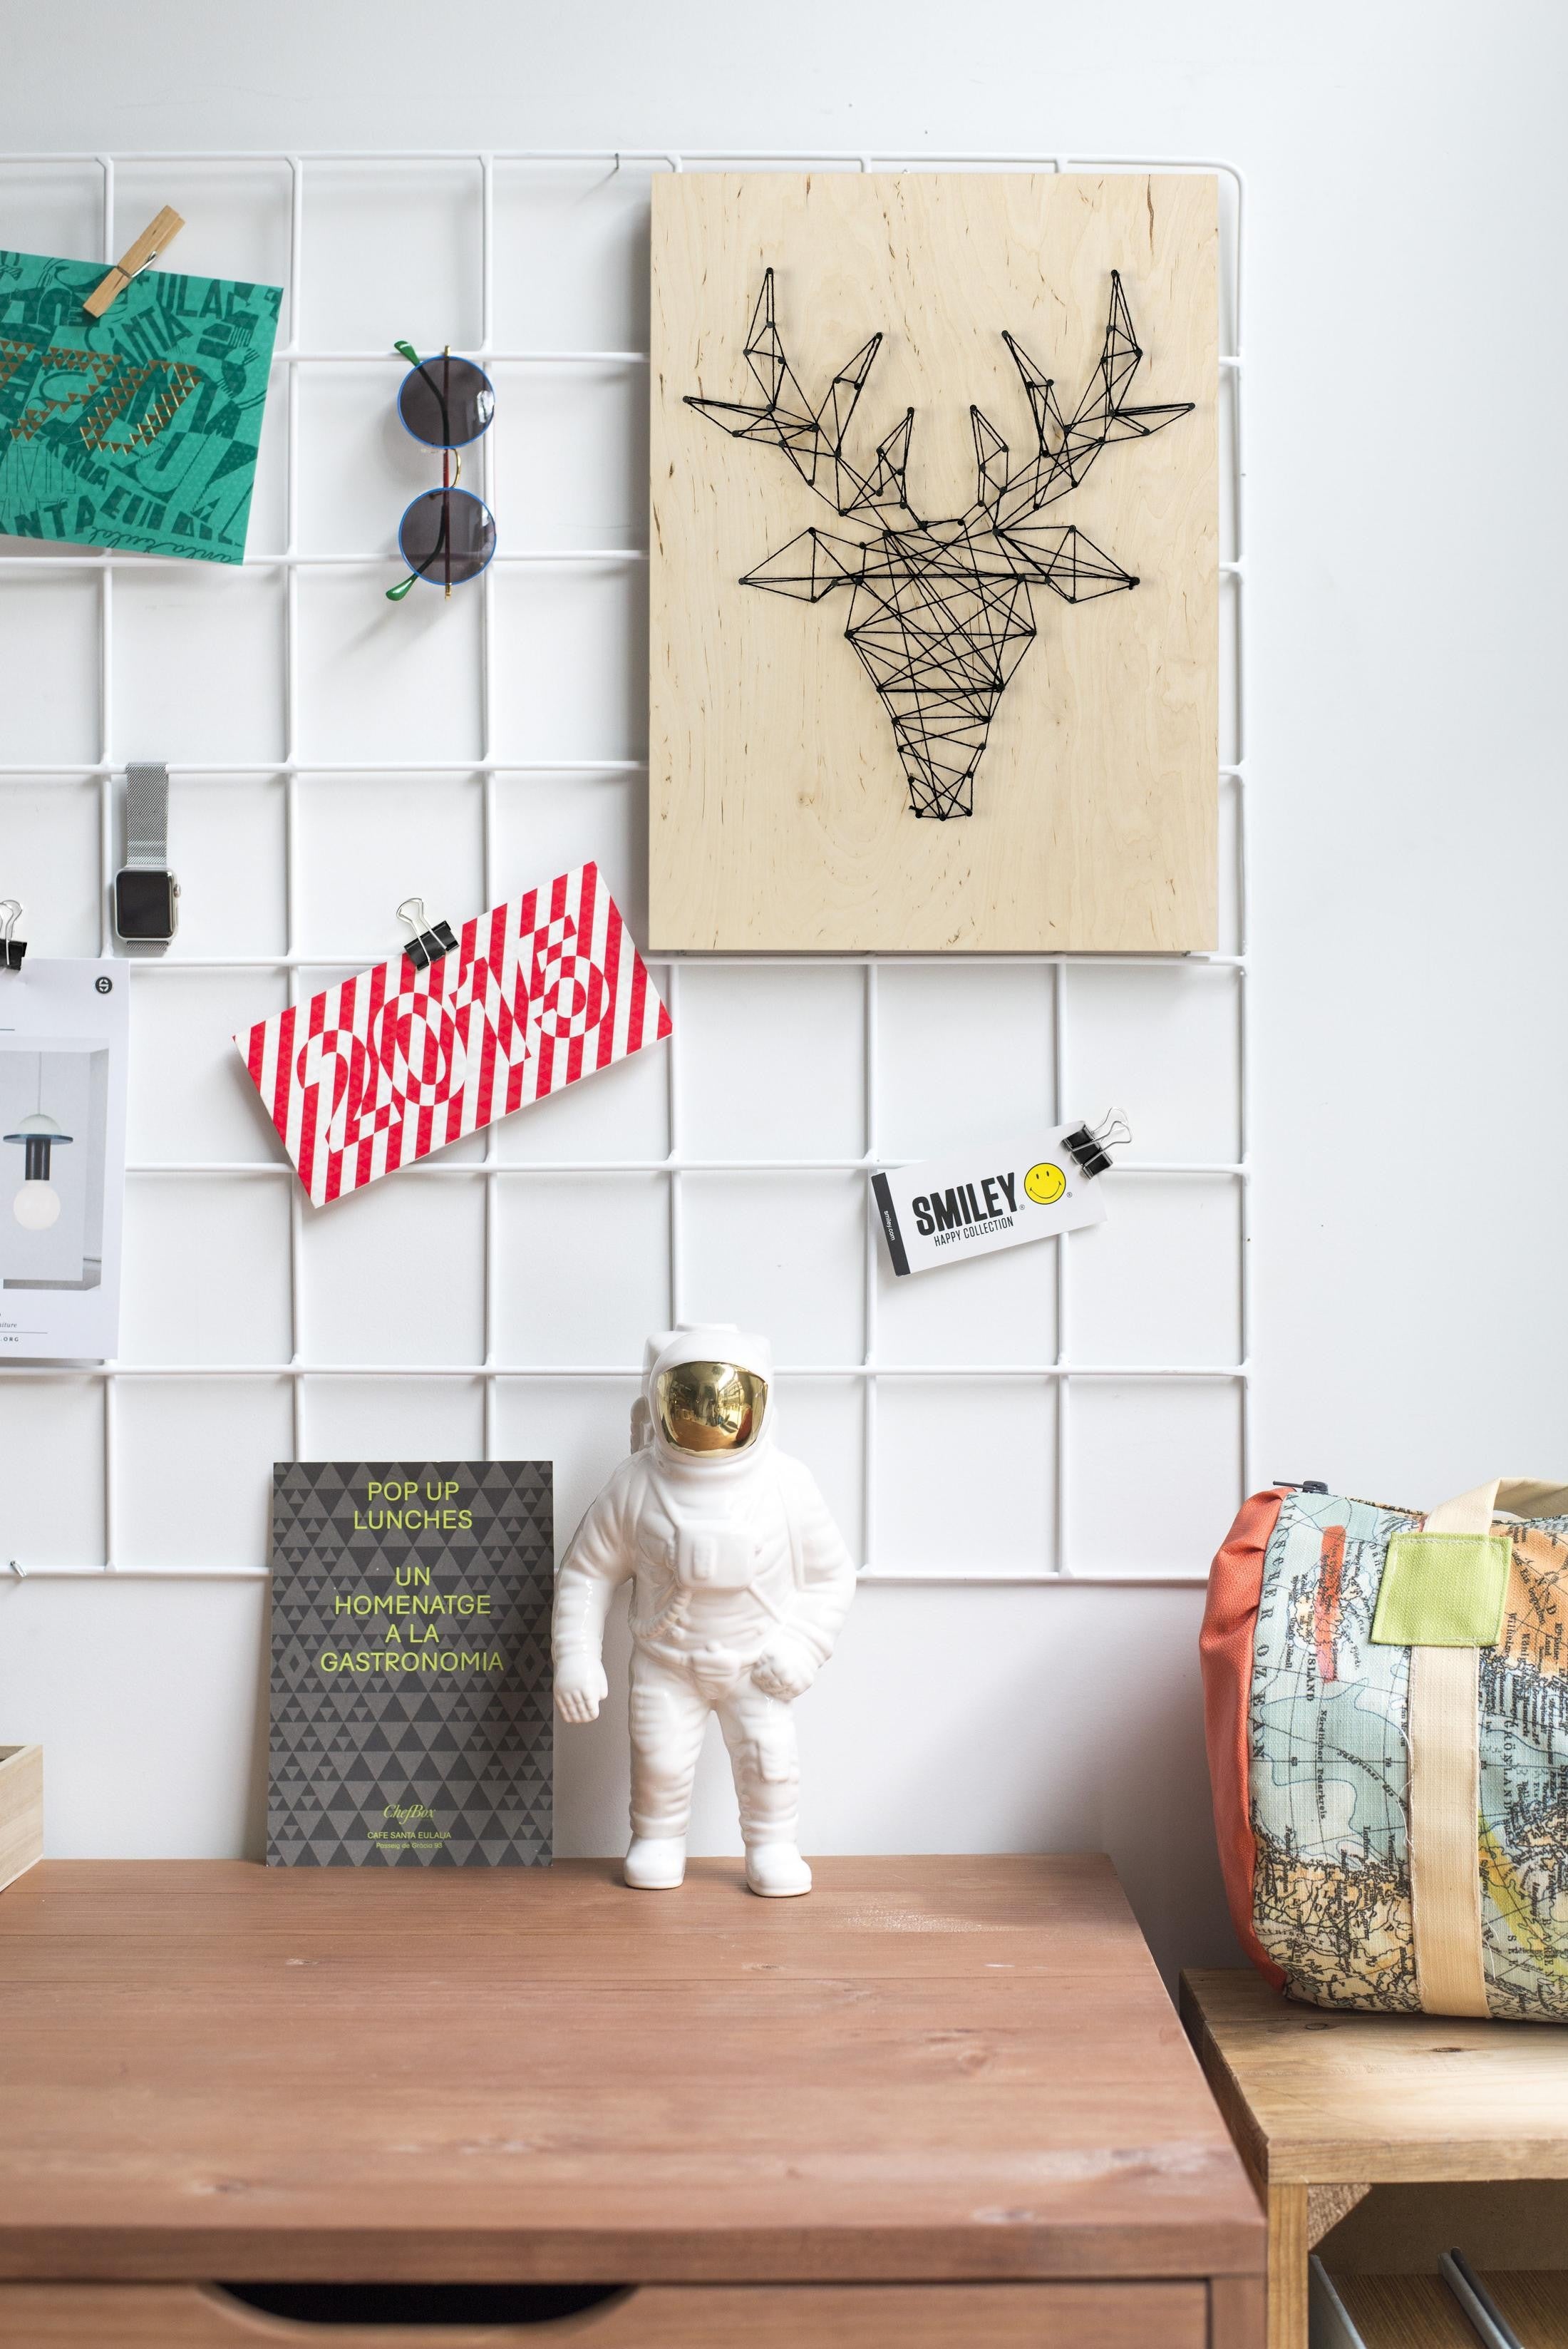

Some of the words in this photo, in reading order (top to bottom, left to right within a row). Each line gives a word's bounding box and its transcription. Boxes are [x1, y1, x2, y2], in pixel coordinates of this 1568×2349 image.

[296, 914, 611, 1154] 2015
[912, 1172, 1018, 1236] SMILEY
[884, 1210, 896, 1241] smiley.com
[934, 1228, 962, 1247] HAPPY
[963, 1216, 1014, 1239] COLLECTION
[368, 1481, 418, 1501] POP
[426, 1481, 460, 1501] UP
[354, 1509, 473, 1530] LUNCHES
[396, 1566, 431, 1586] UN
[334, 1595, 492, 1615] HOMENATGE
[385, 1624, 403, 1643] A
[410, 1623, 440, 1643] LA
[320, 1652, 505, 1672] GASTRONOMIA
[1306, 1652, 1318, 1702] ISLAND
[383, 1804, 436, 1825] ChefBox
